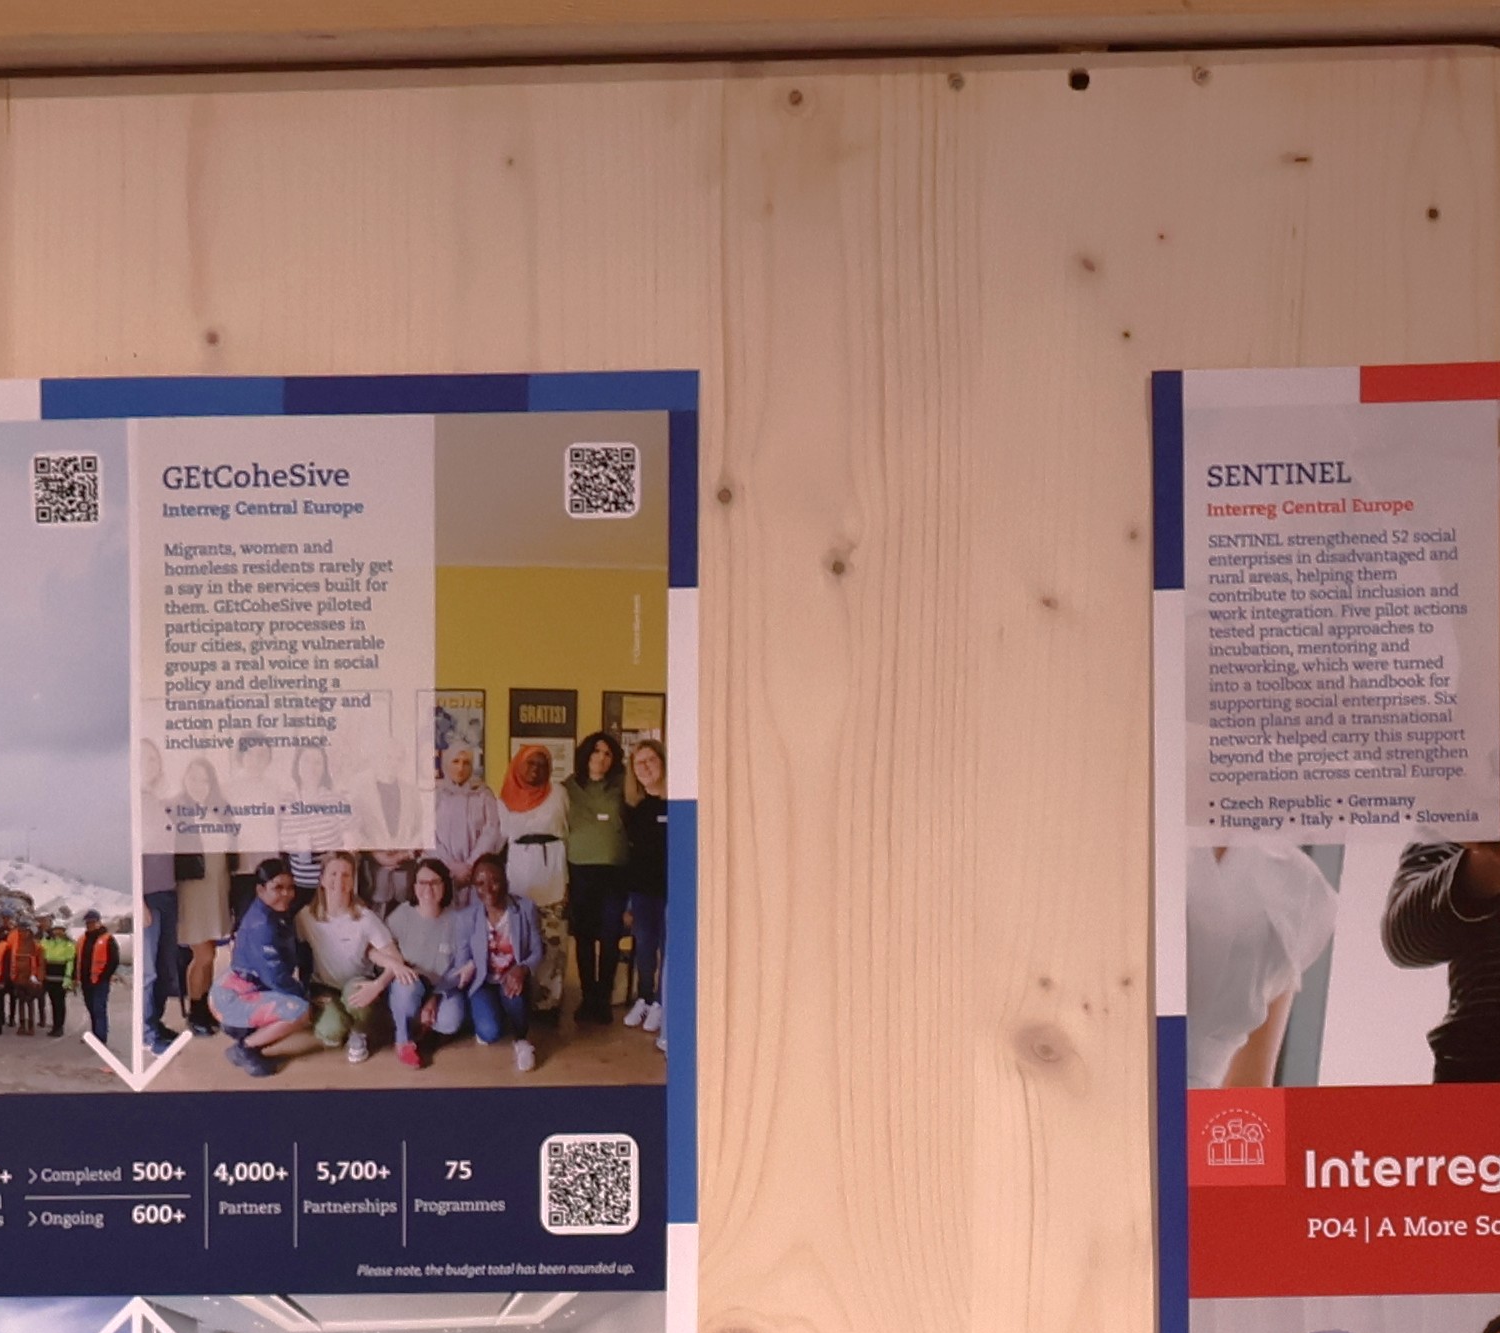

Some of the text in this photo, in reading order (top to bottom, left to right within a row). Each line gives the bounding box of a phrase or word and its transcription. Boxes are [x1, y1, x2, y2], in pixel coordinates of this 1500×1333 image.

[161, 461, 350, 490] GEtCoheSive
[1206, 460, 1352, 488] SENTINEL
[162, 498, 364, 521] Interreg Central Europe
[132, 1161, 186, 1182] 500+
[213, 1161, 288, 1186] 4,000+
[316, 1160, 391, 1185] 5,700+
[445, 1159, 472, 1180] 75
[413, 1197, 506, 1216] Programmes
[1307, 1217, 1358, 1239] PO4
[1376, 1216, 1396, 1237] A
[1403, 1215, 1468, 1237] More
